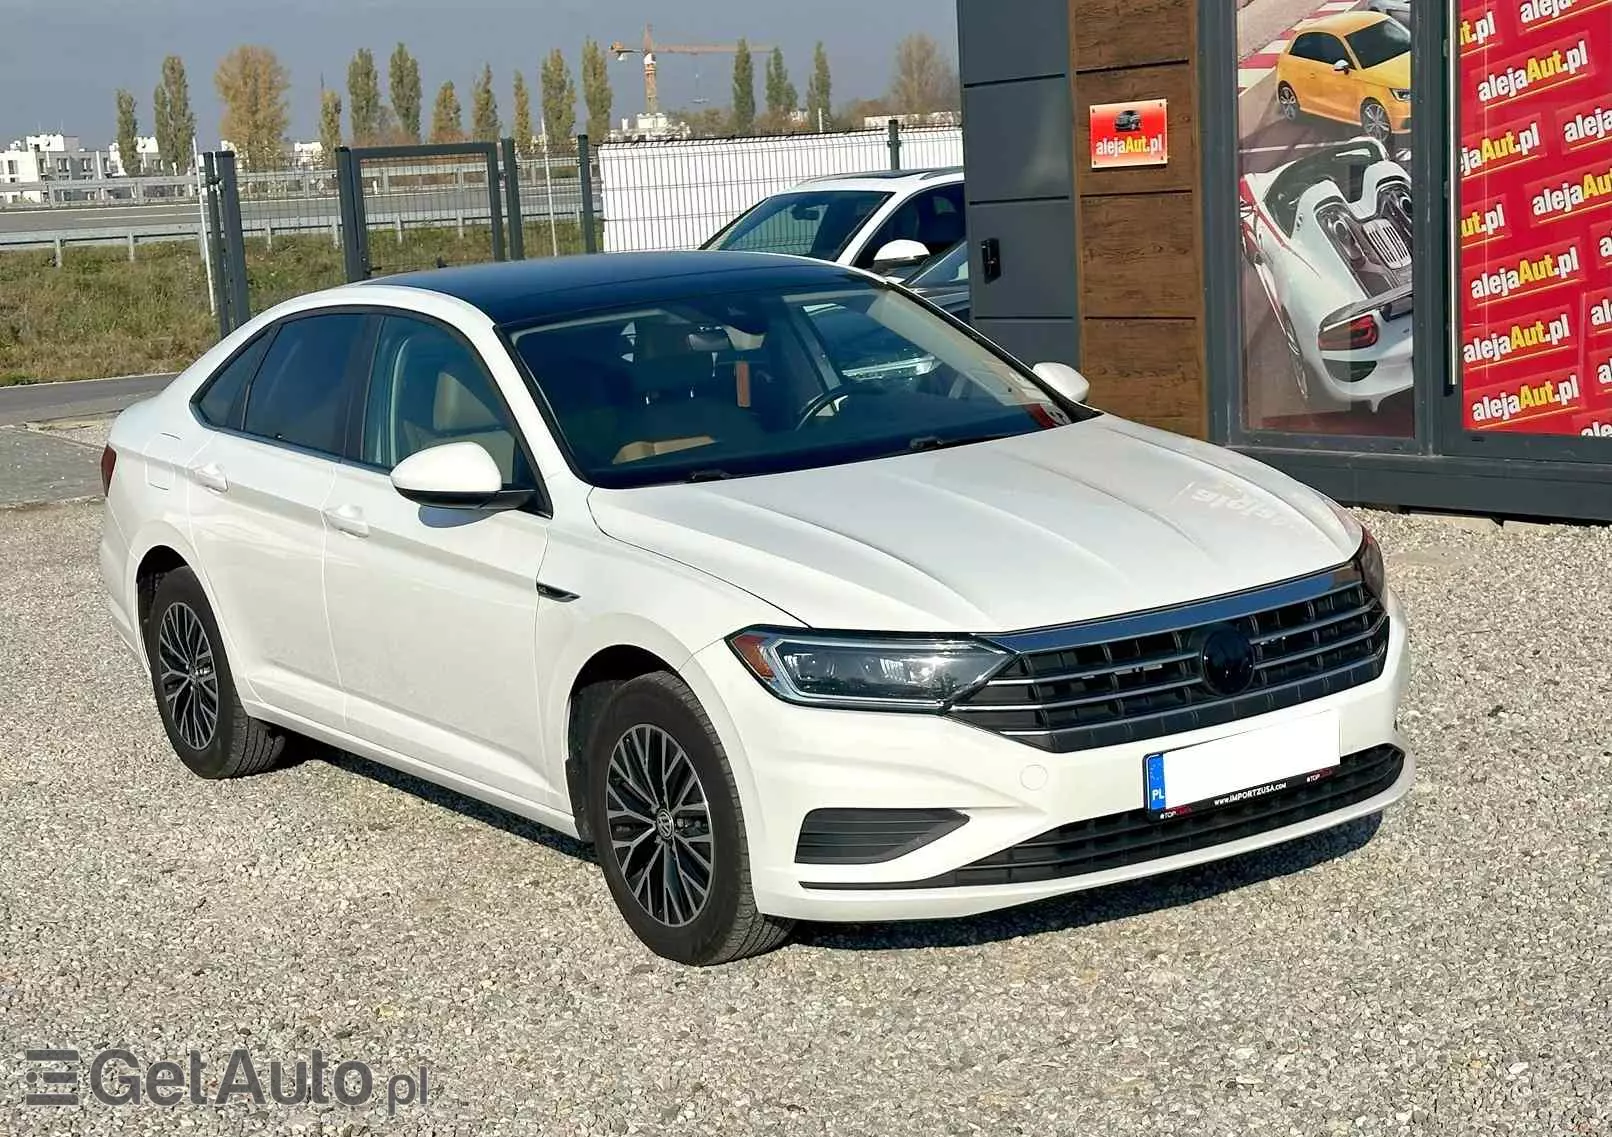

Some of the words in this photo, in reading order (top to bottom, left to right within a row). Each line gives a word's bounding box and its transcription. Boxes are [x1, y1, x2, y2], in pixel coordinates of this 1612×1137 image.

[1520, 0, 1577, 23] alej
[1477, 41, 1588, 101] alejaAut.pl
[1096, 134, 1163, 157] alejaAut.pl
[1461, 122, 1540, 176] jaAut.pl
[1533, 168, 1612, 212] alejaAu
[1471, 247, 1579, 299] alejaAut.pl
[1463, 314, 1570, 363] alejaAut.pl
[1472, 375, 1580, 420] alejaAut.pl
[1152, 788, 1165, 800] PL
